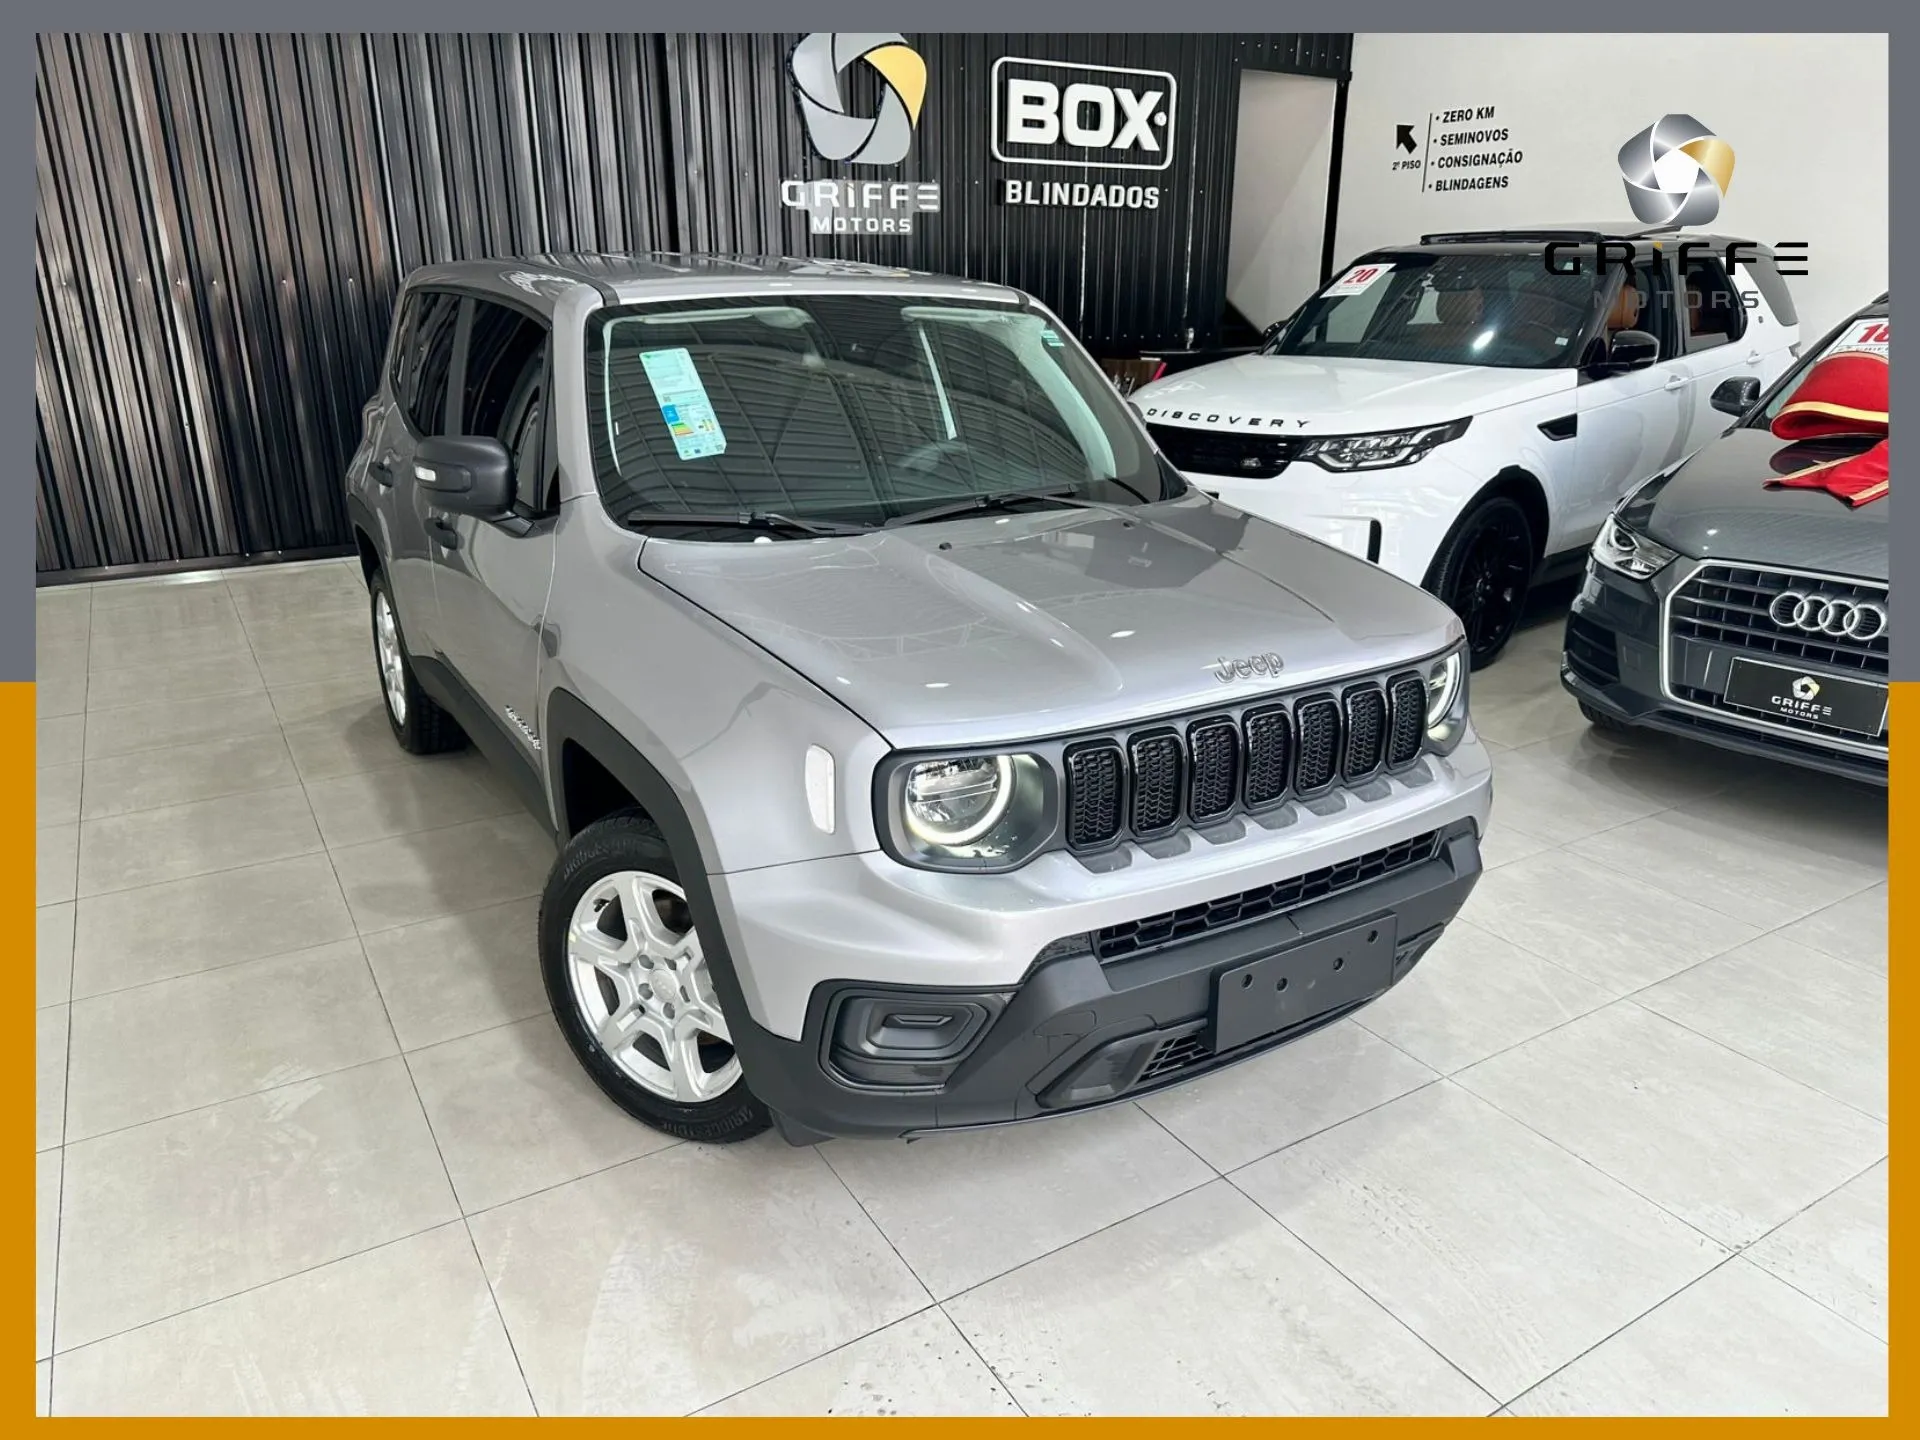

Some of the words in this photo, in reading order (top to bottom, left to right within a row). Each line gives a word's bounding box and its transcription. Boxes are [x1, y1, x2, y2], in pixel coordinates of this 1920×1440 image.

[1442, 108, 1473, 124] ZERO
[1476, 106, 1495, 120] KM
[1440, 128, 1509, 146] SEMINOVOS
[1401, 160, 1421, 170] PISO
[1437, 148, 1523, 168] CONSIGNAÇÃO
[1435, 176, 1509, 192] BLINDAGENS
[781, 180, 939, 210] GRIFFE
[1005, 179, 1160, 210] BLINDADOS
[813, 216, 911, 233] MOTORS
[1343, 268, 1378, 284] 20
[1146, 408, 1310, 428] DISCOVERY
[1214, 652, 1284, 683] Jeep
[1771, 695, 1833, 716] GRIFFE
[1780, 707, 1819, 720] MOTORS
